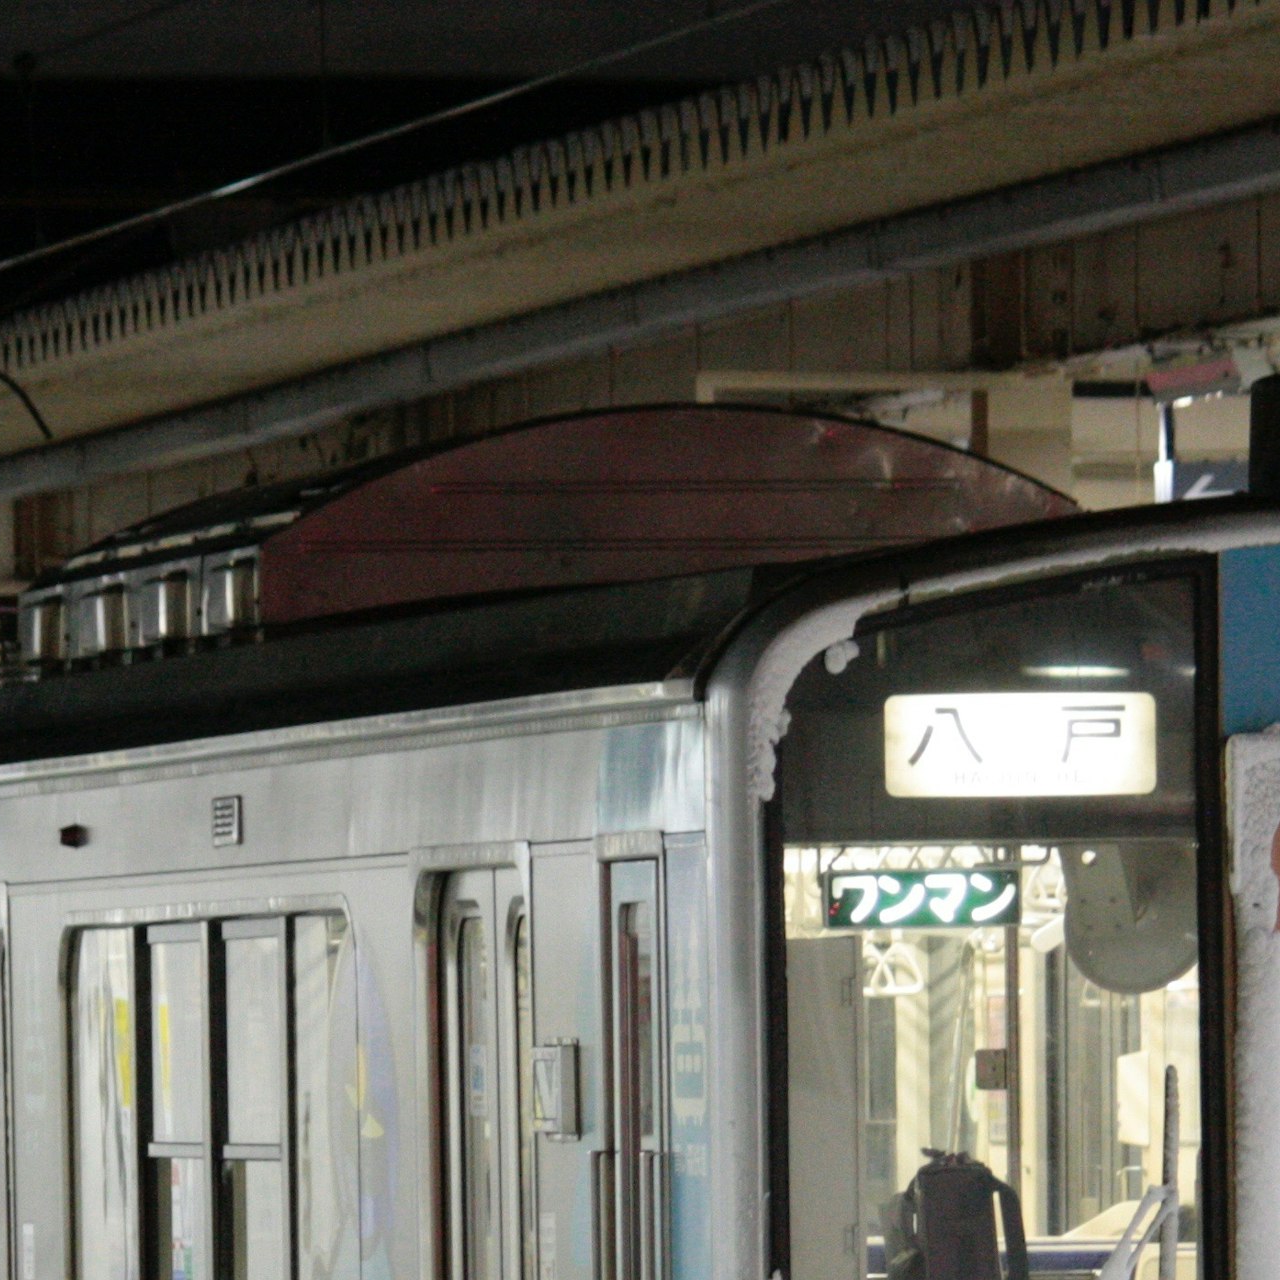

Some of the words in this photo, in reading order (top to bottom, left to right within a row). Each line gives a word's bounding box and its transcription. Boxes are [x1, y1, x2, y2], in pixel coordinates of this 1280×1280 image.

[907, 702, 1127, 768] 八戸
[833, 872, 1016, 924] ワンマン
